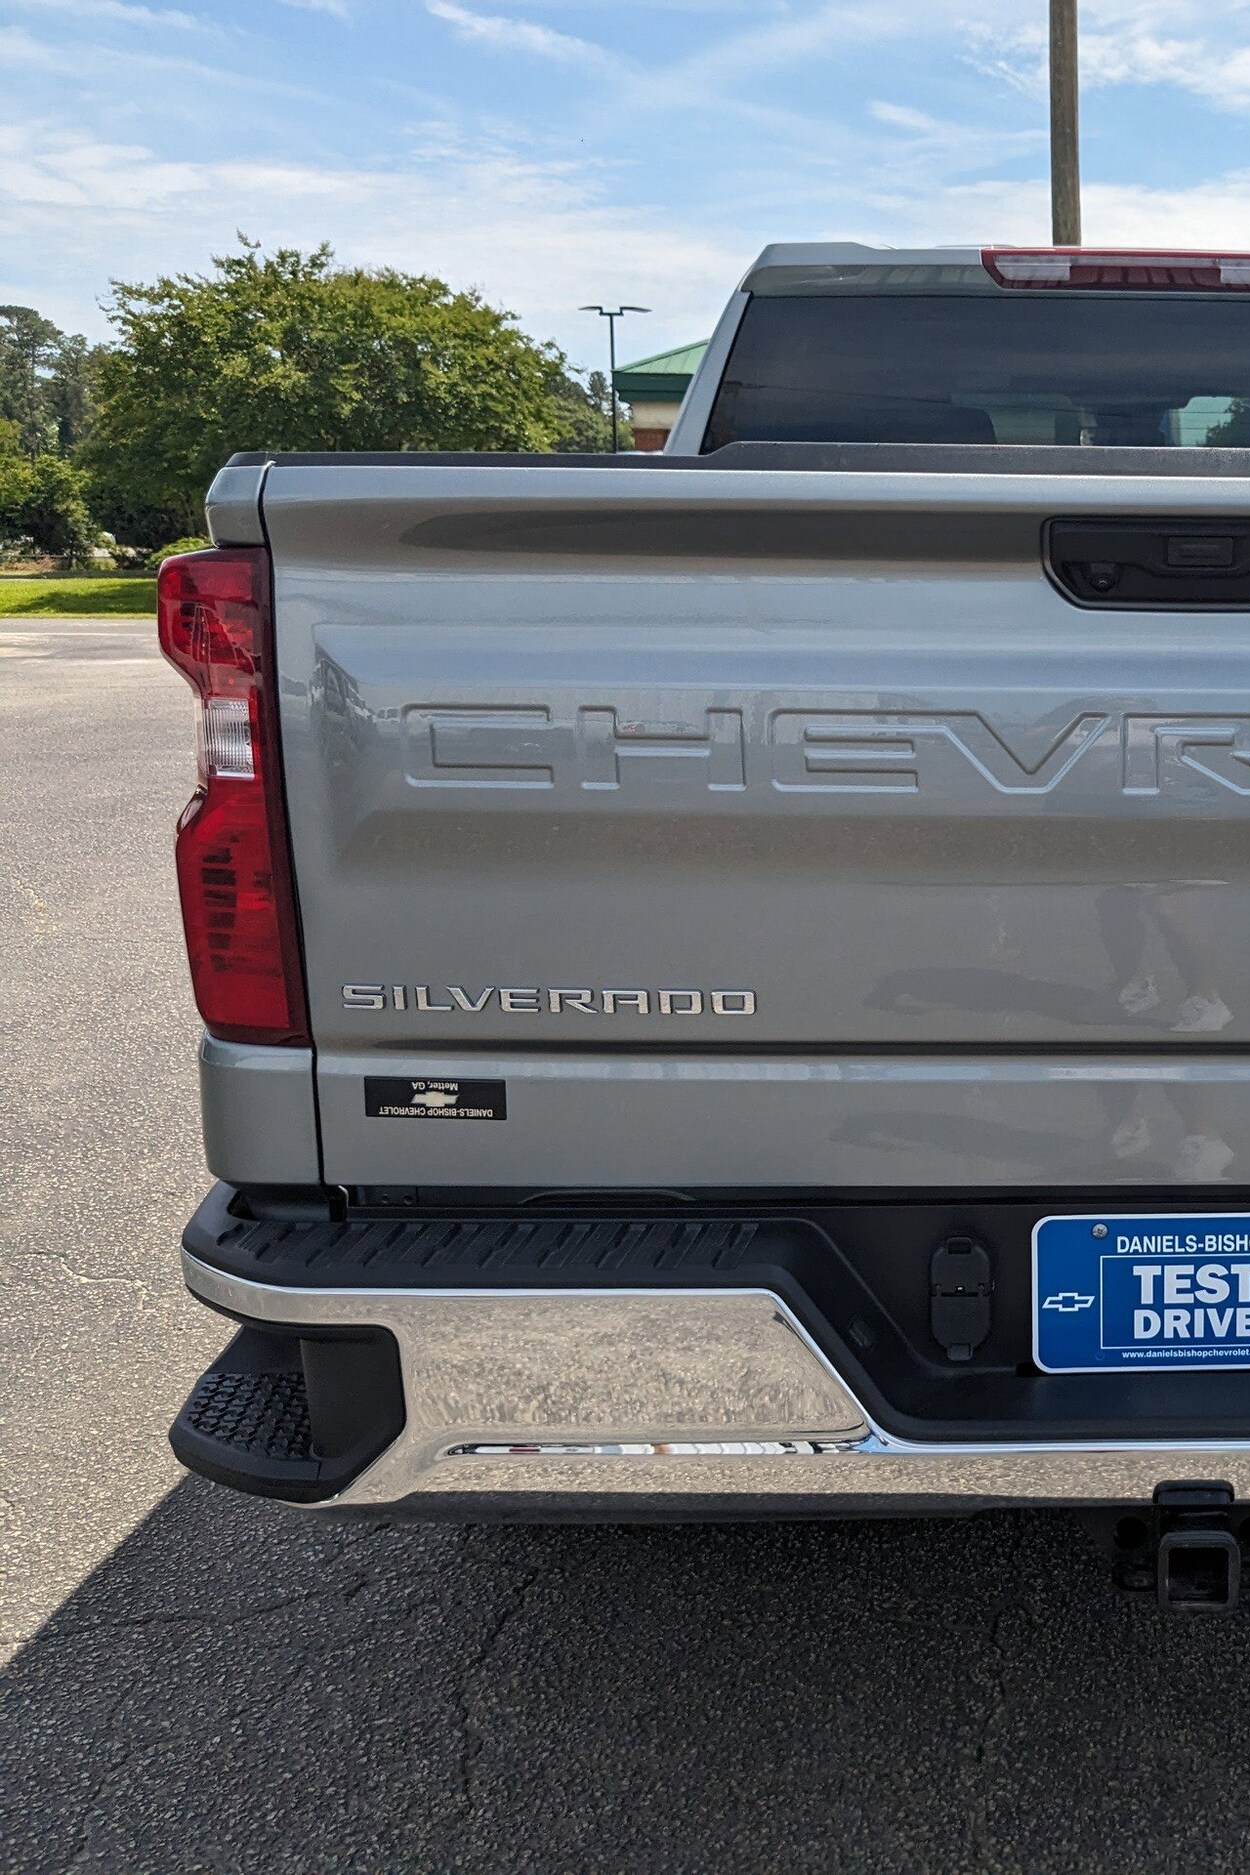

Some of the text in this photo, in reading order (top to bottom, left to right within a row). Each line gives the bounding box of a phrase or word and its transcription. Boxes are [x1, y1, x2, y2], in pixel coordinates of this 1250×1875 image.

[341, 983, 757, 1015] SILVERADO
[411, 1081, 459, 1091] Metter, GA
[379, 1106, 493, 1117] DANIELS-BISHOP CHEVROLET
